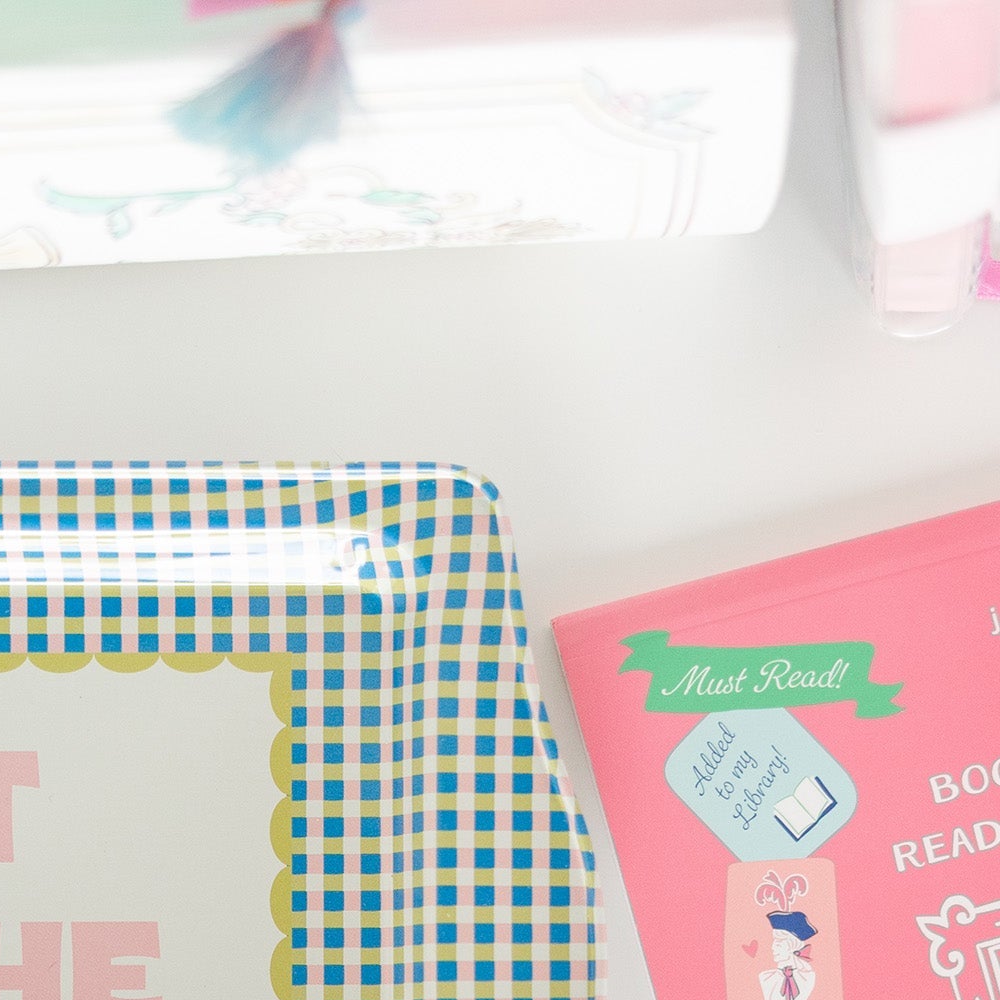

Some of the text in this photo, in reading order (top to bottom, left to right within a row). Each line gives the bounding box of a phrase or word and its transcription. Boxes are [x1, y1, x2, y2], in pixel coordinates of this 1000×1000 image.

[661, 658, 850, 697] Must Read!
[693, 721, 736, 796] Added
[715, 750, 759, 800] to my
[733, 744, 790, 831] Library!
[892, 820, 1000, 873] READ
